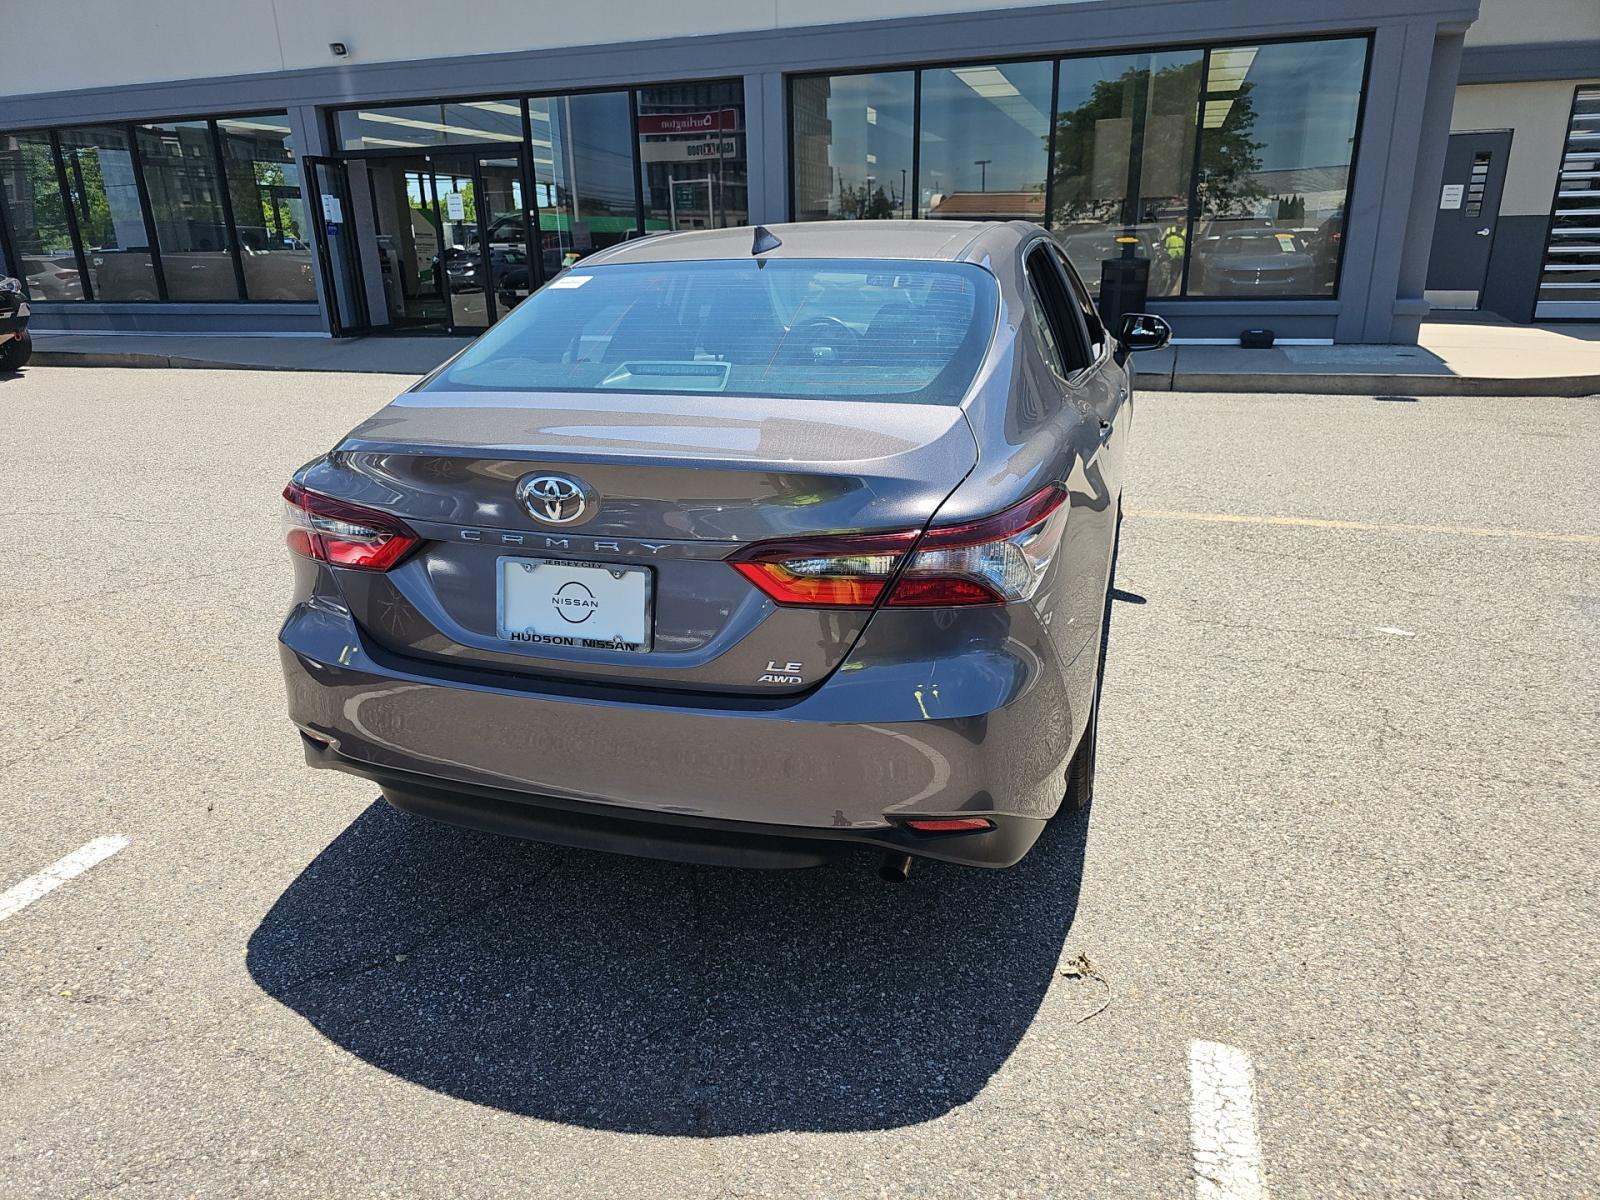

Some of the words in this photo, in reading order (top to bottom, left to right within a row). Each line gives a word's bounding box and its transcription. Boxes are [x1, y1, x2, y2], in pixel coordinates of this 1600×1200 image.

[460, 529, 672, 554] CAMRY
[543, 559, 578, 567] JERSEY
[581, 561, 602, 569] CITY
[552, 597, 599, 608] NISSAN
[511, 632, 574, 646] HUDSON
[582, 638, 636, 651] NISSAN
[765, 661, 803, 673] LE
[757, 674, 802, 684] AWD
